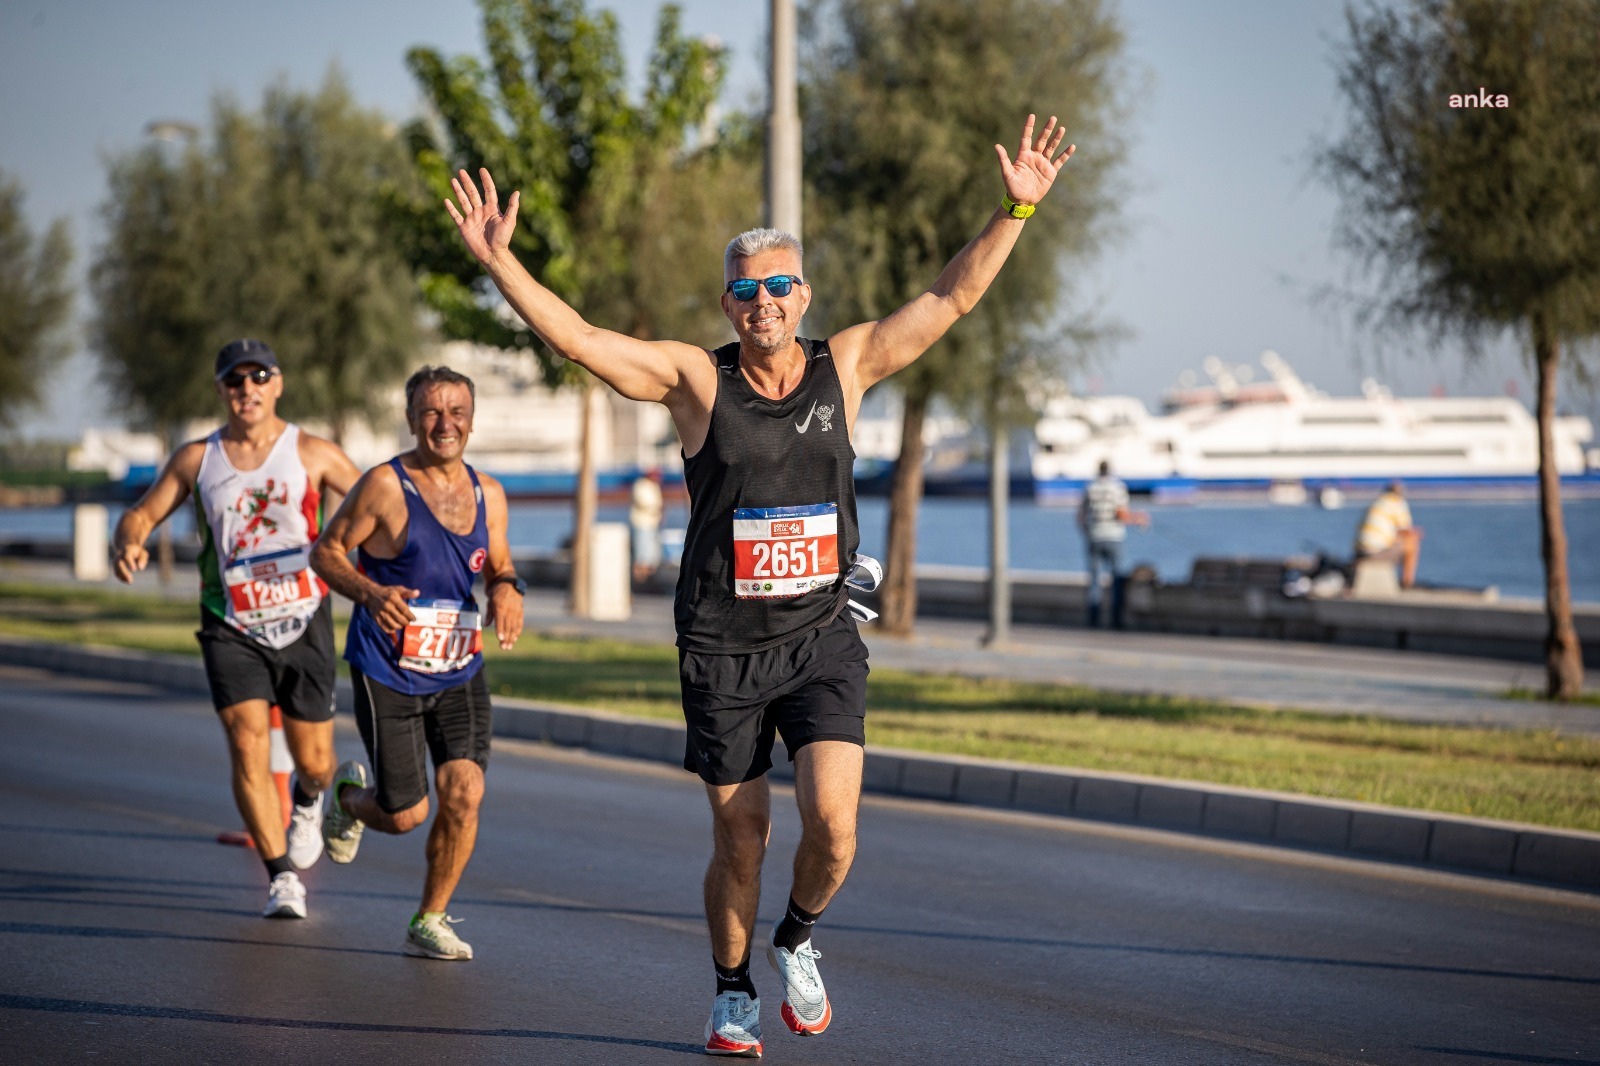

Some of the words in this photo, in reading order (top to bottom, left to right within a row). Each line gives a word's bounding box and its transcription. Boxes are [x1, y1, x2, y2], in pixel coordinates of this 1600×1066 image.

[752, 539, 819, 577] 2651
[242, 574, 300, 610] 1280
[417, 627, 472, 659] 2707
